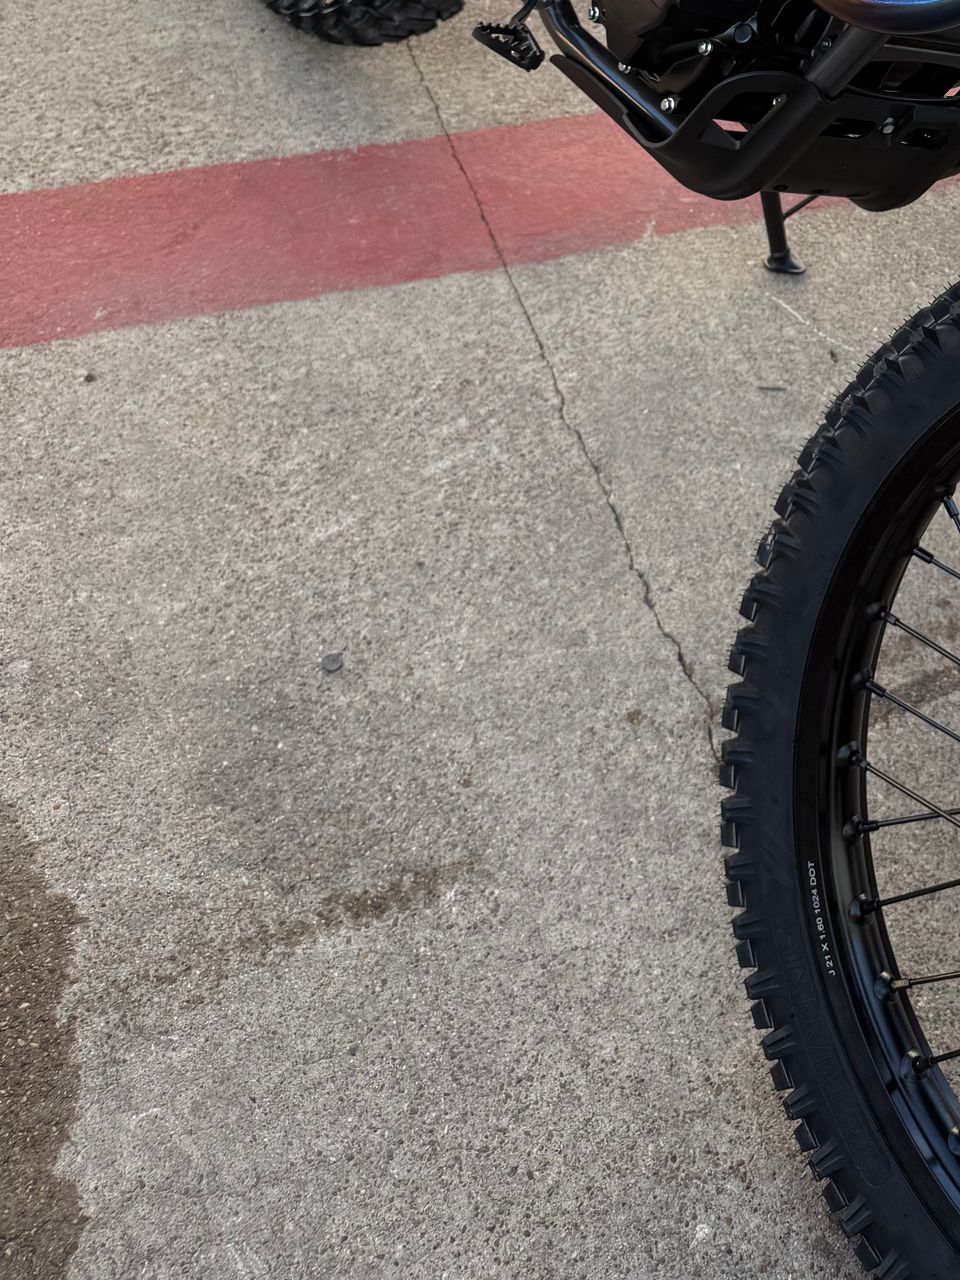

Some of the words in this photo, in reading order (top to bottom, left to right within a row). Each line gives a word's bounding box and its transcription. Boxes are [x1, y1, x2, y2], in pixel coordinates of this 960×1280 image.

[807, 860, 818, 887] DOT
[811, 888, 821, 915] 1024
[816, 916, 826, 940] 1.60
[825, 954, 834, 968] 21
